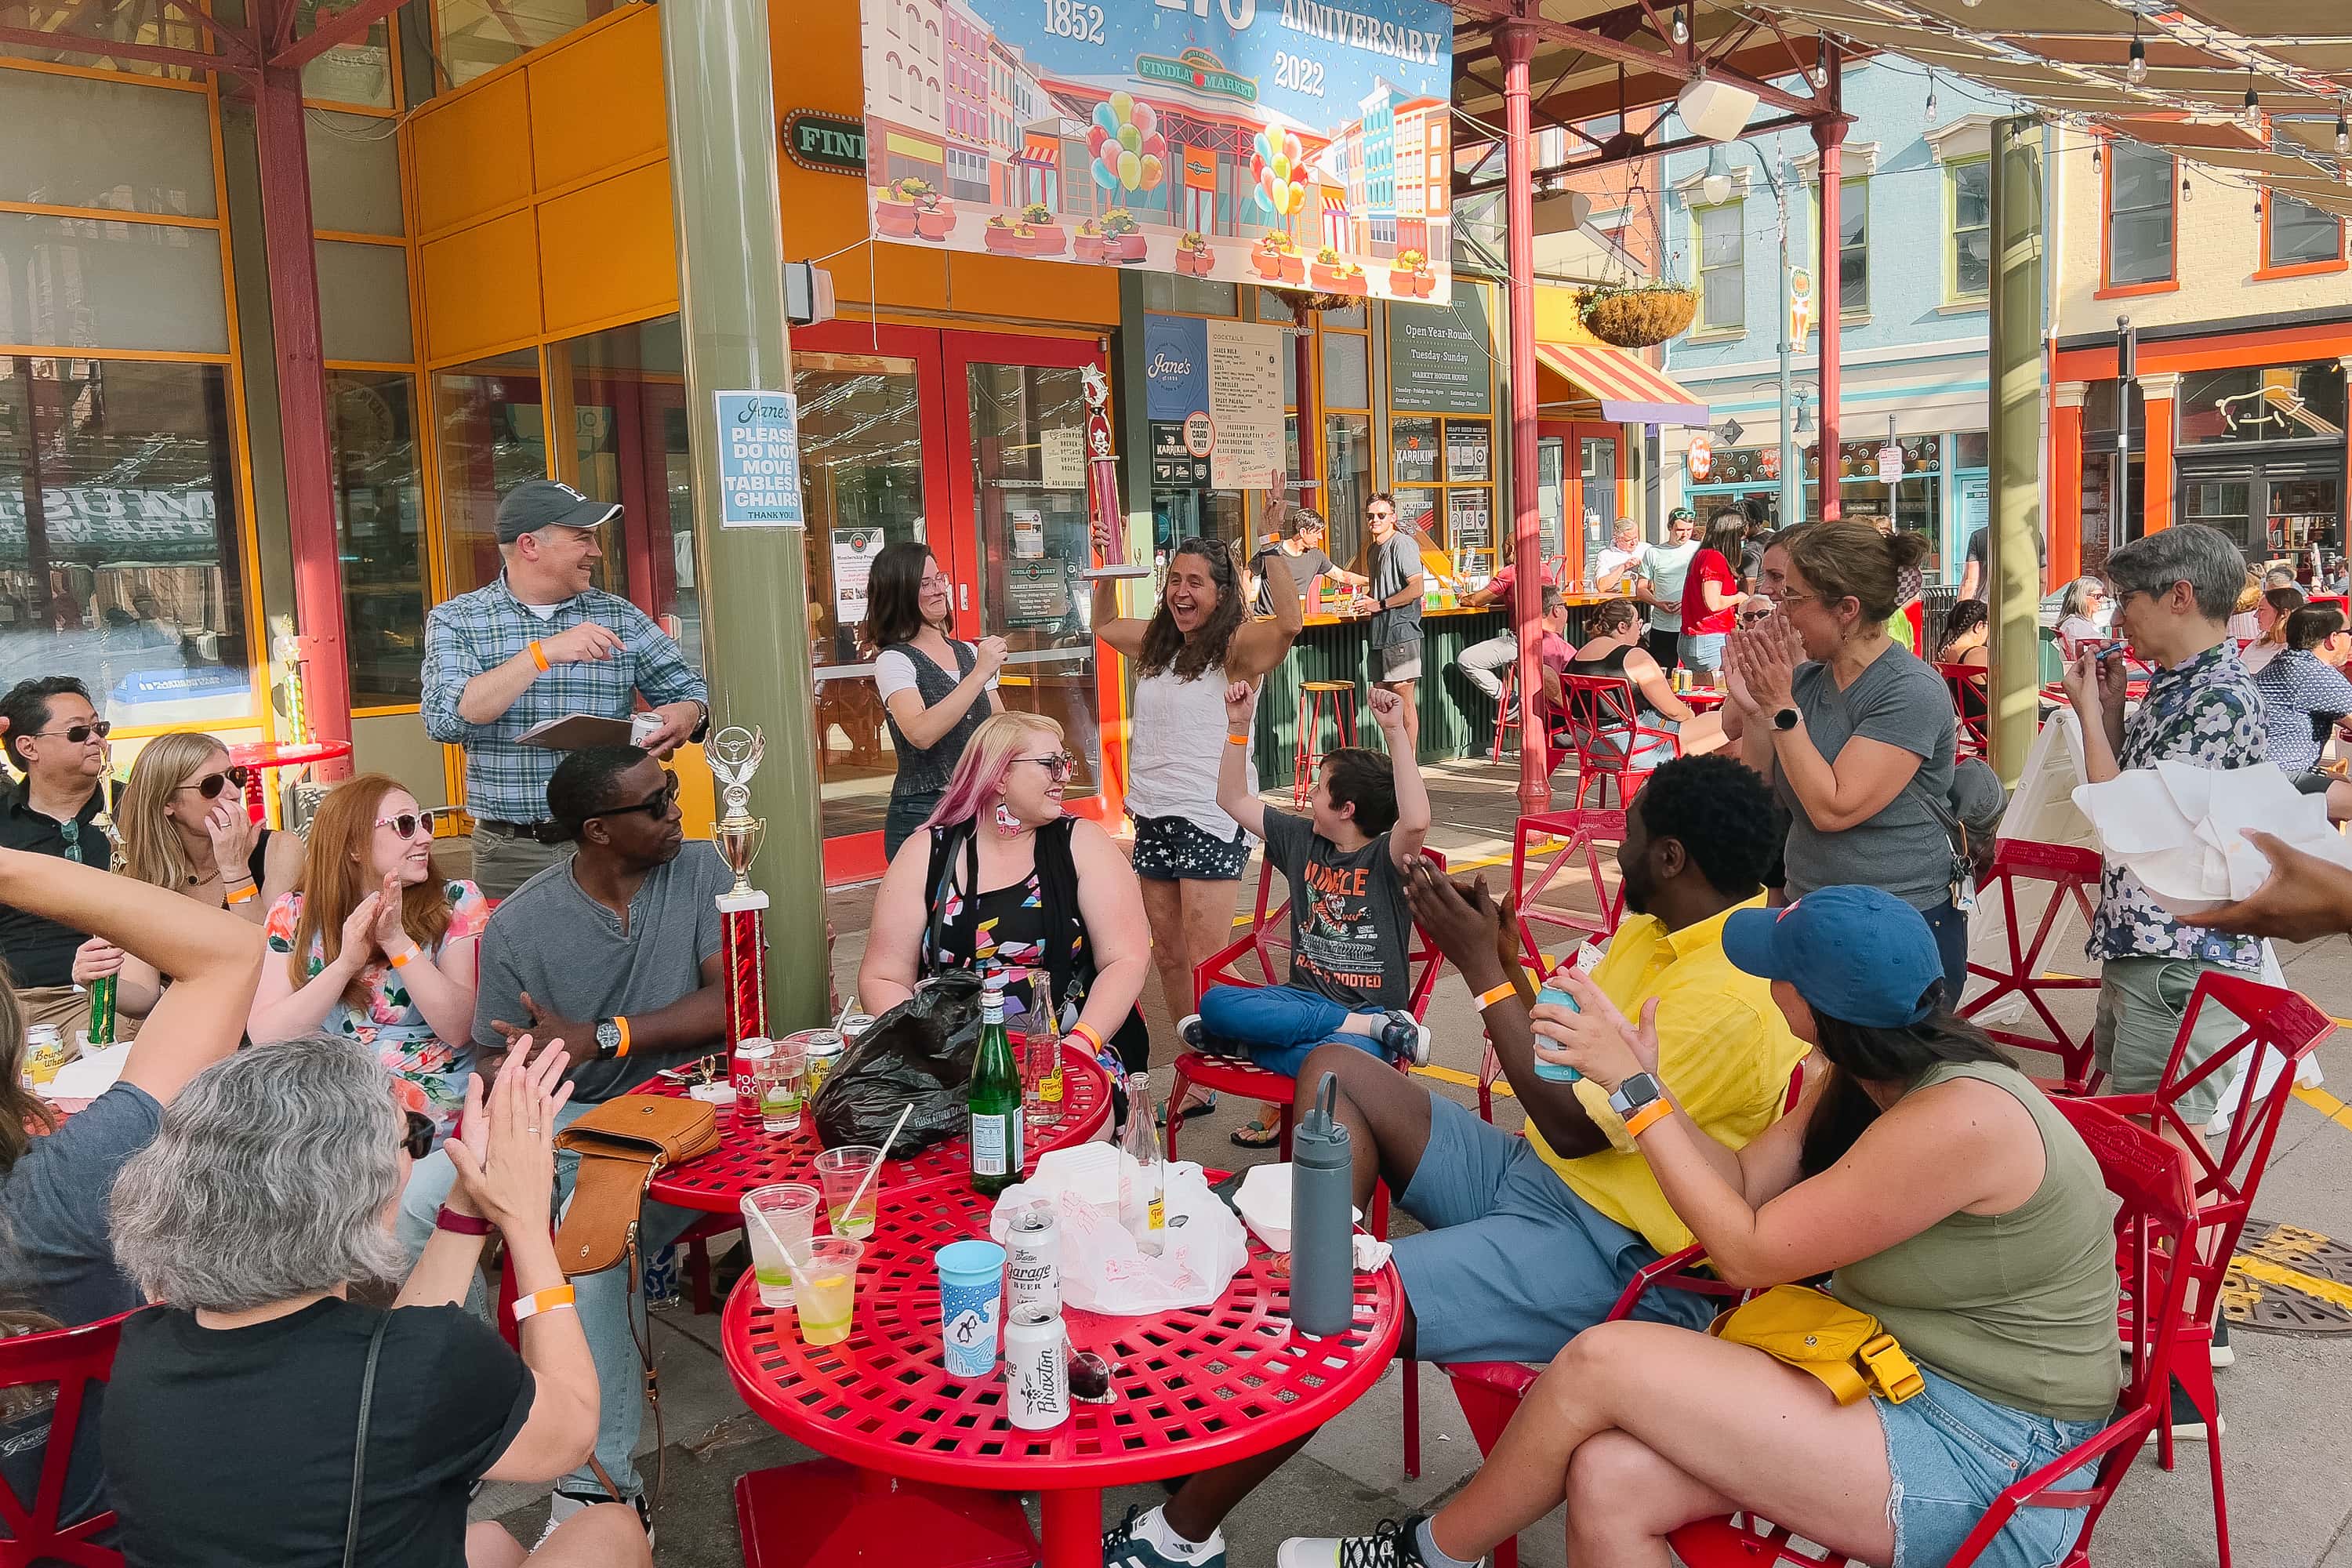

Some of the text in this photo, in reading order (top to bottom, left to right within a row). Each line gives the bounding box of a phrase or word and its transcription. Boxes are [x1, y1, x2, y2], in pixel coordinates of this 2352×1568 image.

[1044, 0, 1105, 45] 1852
[1280, 0, 1442, 67] ANNIVERSARY
[1142, 60, 1254, 98] FINDLAY MARKET
[1274, 51, 1326, 98] 2022
[1406, 324, 1429, 339] Open
[1147, 353, 1192, 378] Jane's
[1412, 371, 1434, 379] MARKET
[738, 397, 790, 424] Jane's
[1190, 420, 1209, 429] CREDIT
[731, 427, 794, 443] PLEASE
[734, 444, 794, 459] DO NOT
[1157, 445, 1188, 456] KARRIKIN
[1396, 449, 1433, 465] KARRIKIN
[742, 459, 792, 475] MOVE
[725, 476, 792, 491] TABLES
[734, 492, 798, 507] CHAIRS
[1401, 501, 1433, 510] NORTHERN
[1014, 1281, 1042, 1290] BEER
[1036, 1348, 1060, 1414] Braxton
